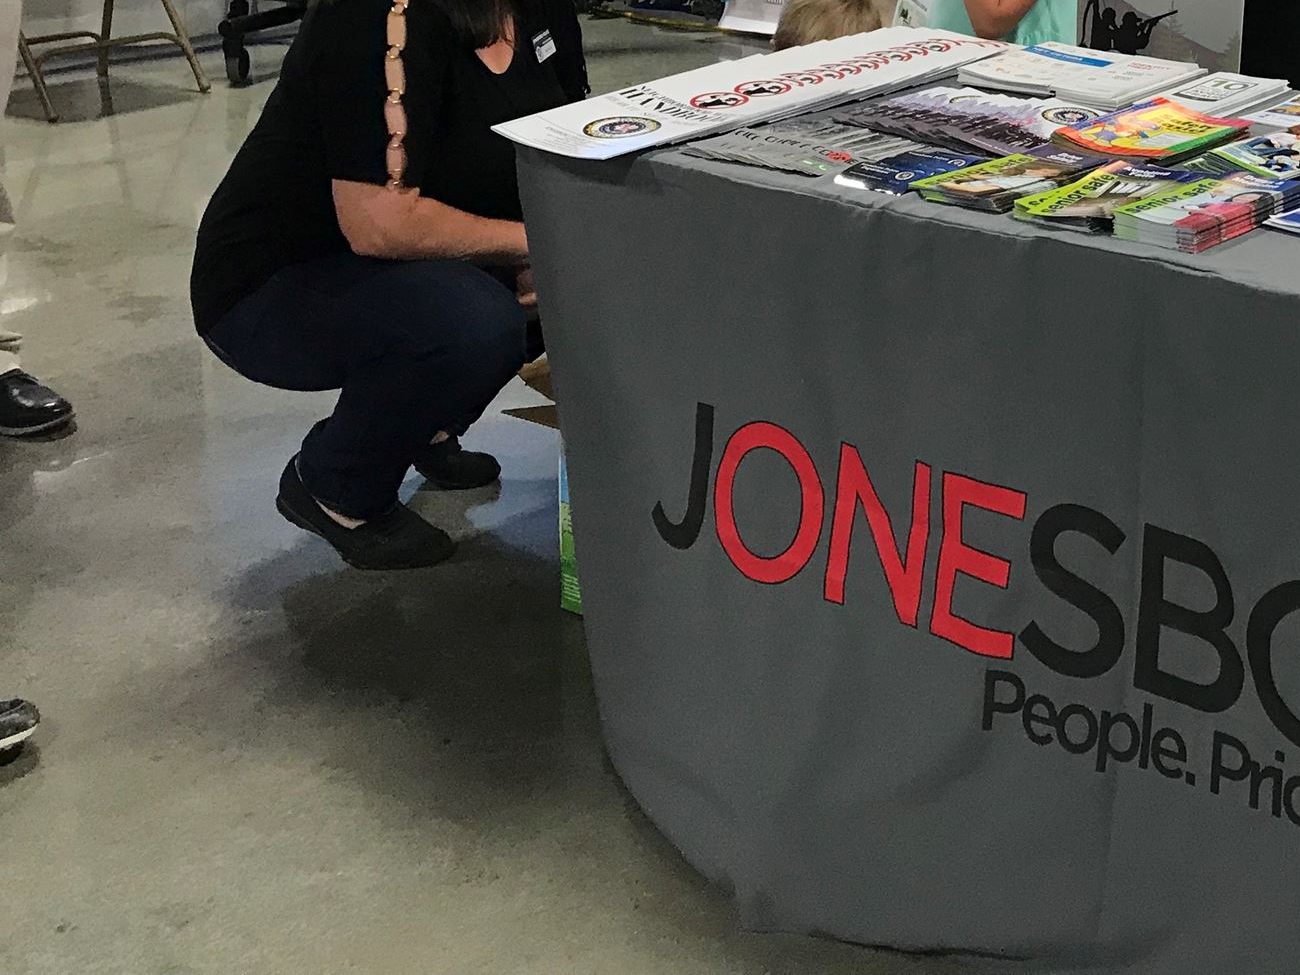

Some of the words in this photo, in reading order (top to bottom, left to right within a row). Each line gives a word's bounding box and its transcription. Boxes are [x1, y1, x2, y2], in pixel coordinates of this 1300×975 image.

[1041, 187, 1084, 213] senior
[1082, 172, 1115, 193] safe
[1125, 194, 1184, 214] senior
[980, 669, 1199, 788] People.
